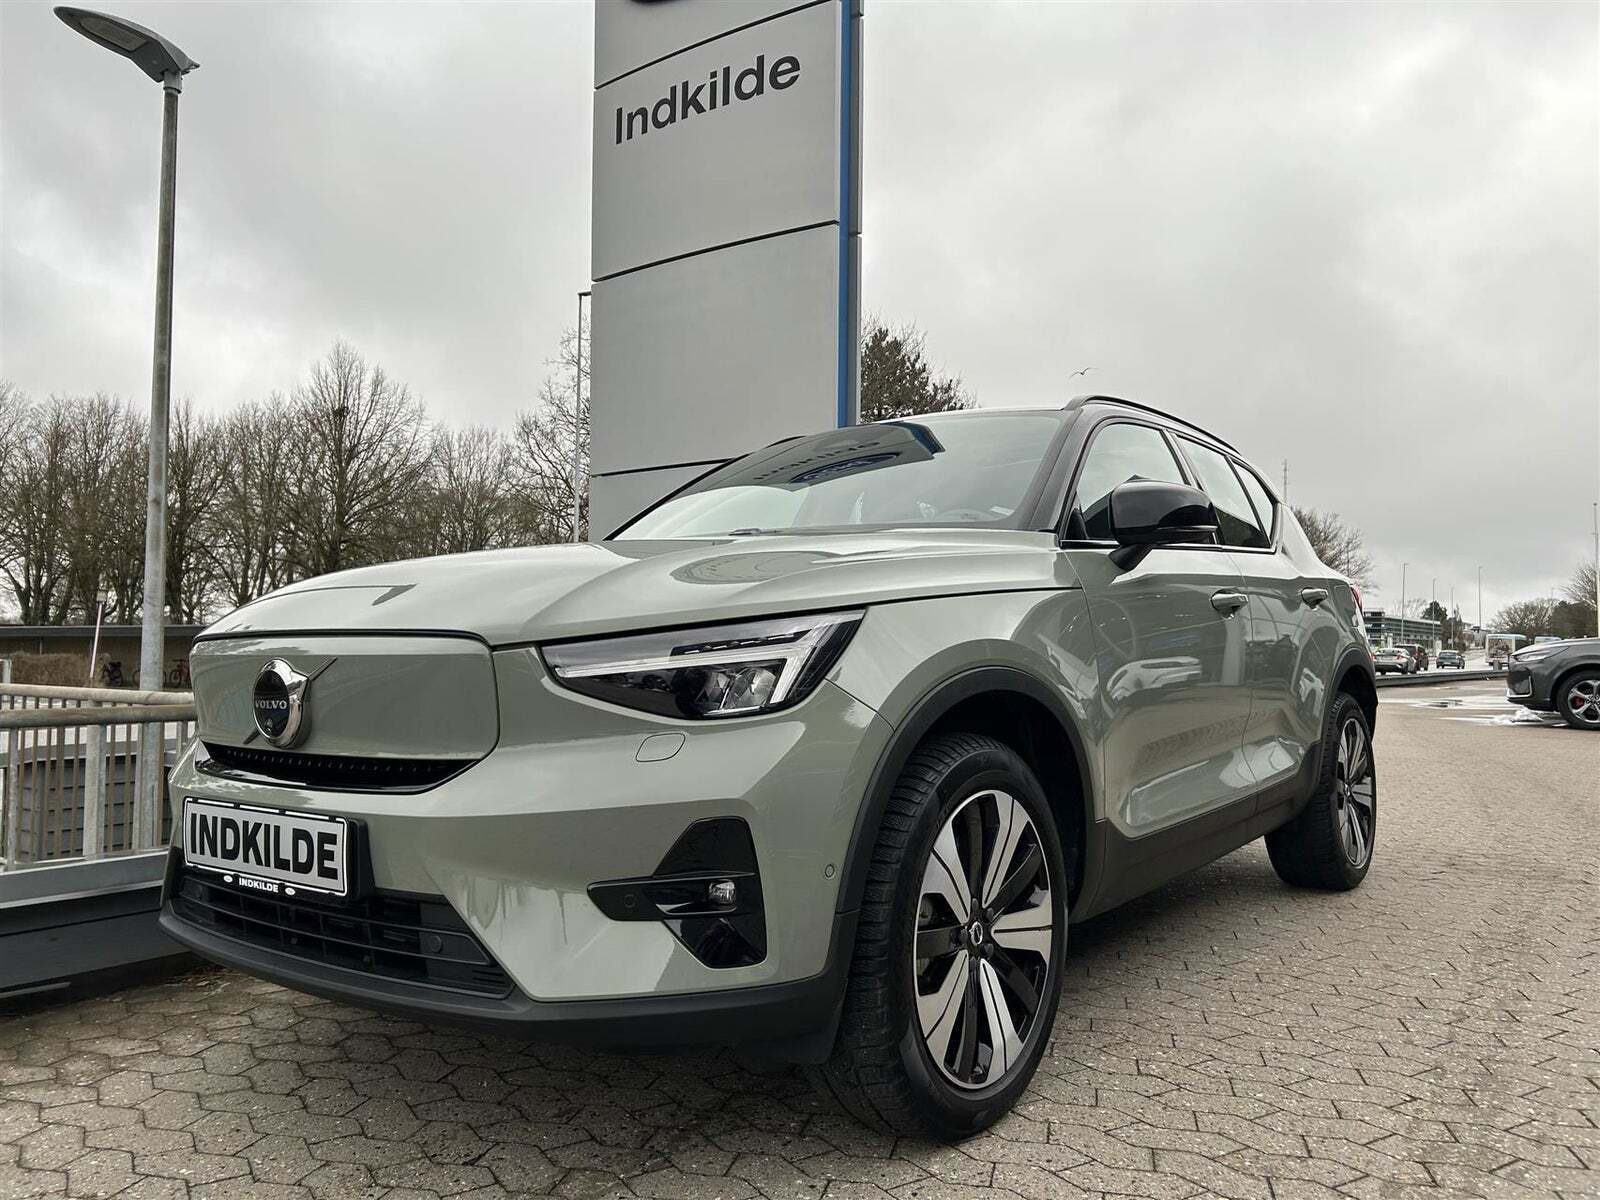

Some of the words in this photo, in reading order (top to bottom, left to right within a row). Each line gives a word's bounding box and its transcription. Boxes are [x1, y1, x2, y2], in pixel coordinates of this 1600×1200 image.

[615, 54, 800, 145] Indkilde
[254, 699, 288, 710] VOLVO
[190, 812, 339, 881] INDKILDE
[238, 877, 279, 893] INDKILDE
